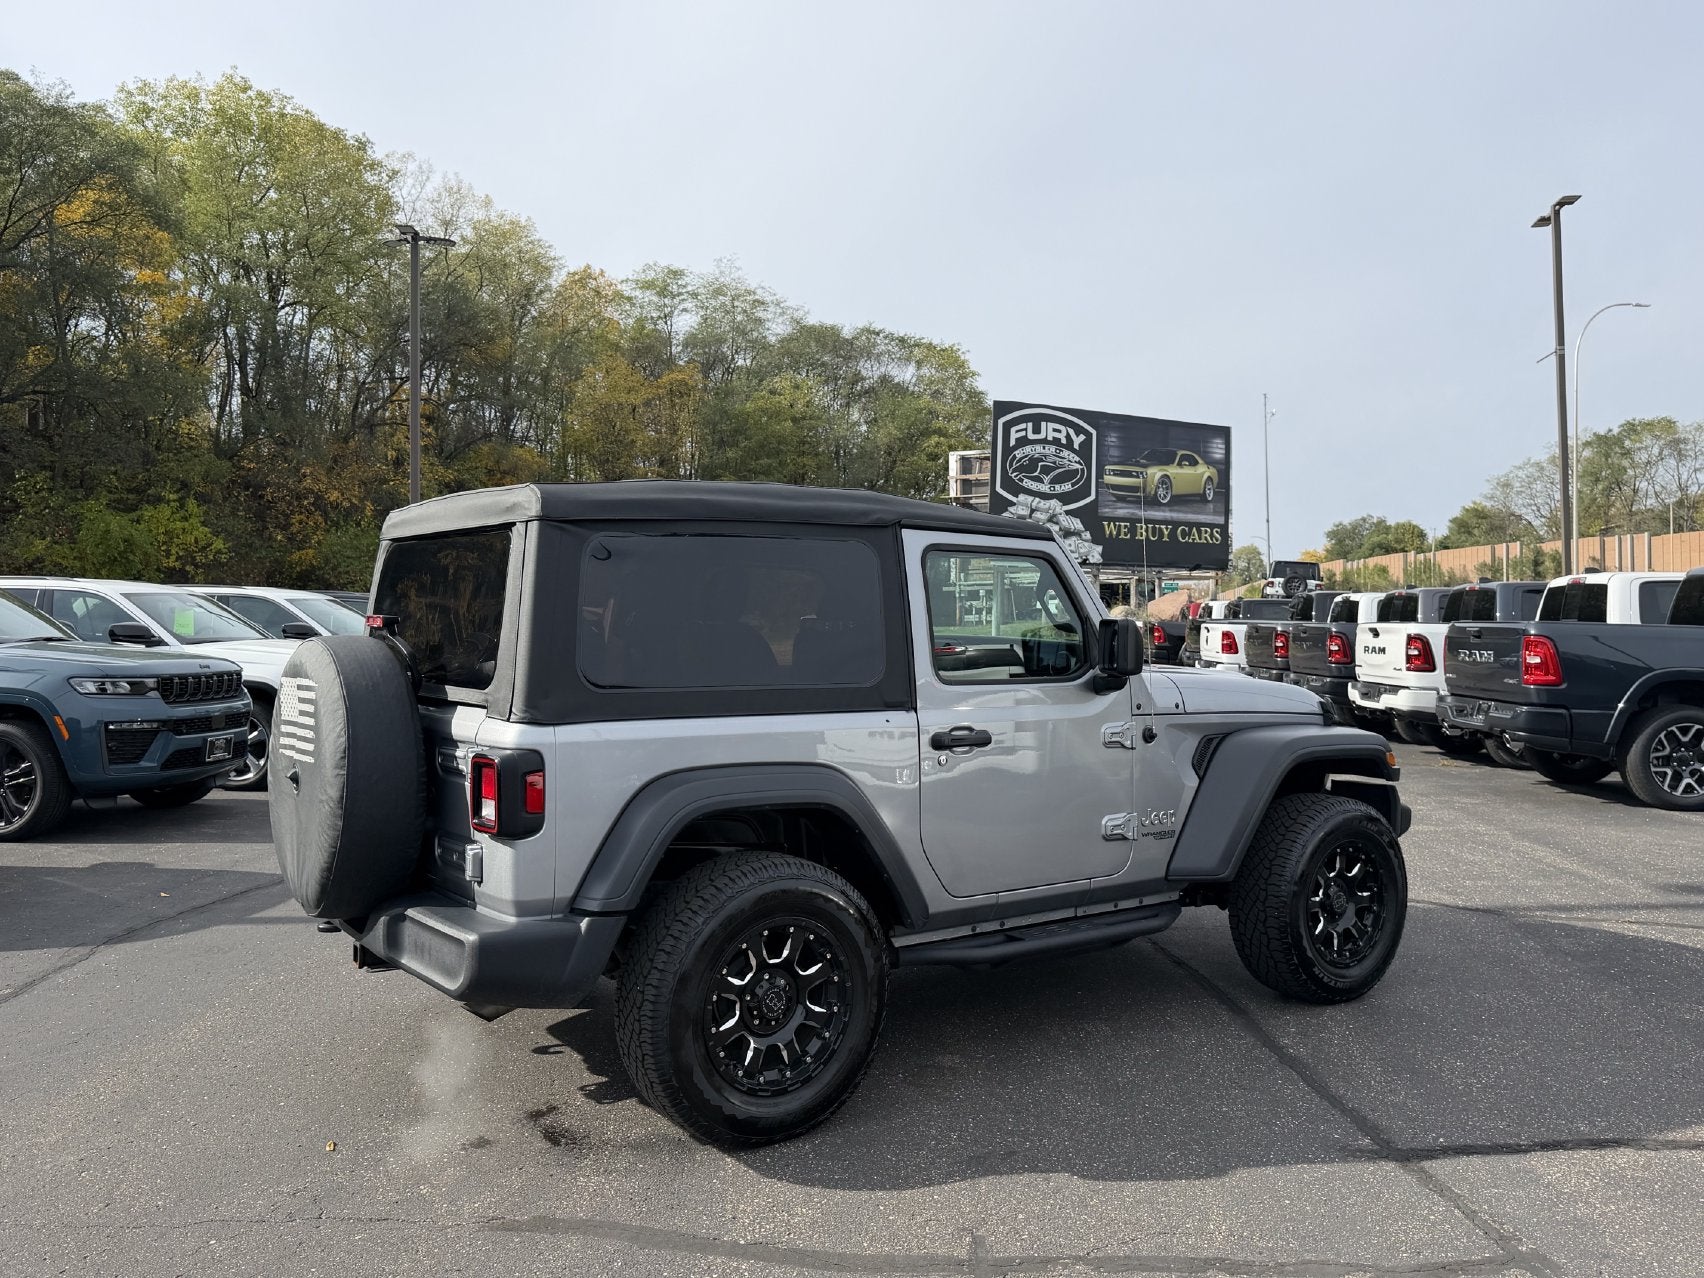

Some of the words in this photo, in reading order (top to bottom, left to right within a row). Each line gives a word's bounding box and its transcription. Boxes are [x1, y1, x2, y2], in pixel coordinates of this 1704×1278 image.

[1009, 421, 1087, 450] FURY
[1015, 444, 1056, 458] CHRYSLER
[1060, 449, 1080, 462] JEEP
[1022, 479, 1050, 491] DODGE
[1055, 483, 1072, 493] RAM
[1102, 521, 1131, 539] WE
[1135, 523, 1173, 541] BUY
[1176, 526, 1222, 544] CARS
[1363, 645, 1387, 655] RAM
[1457, 649, 1495, 662] RAM
[1141, 808, 1175, 827] Jeep
